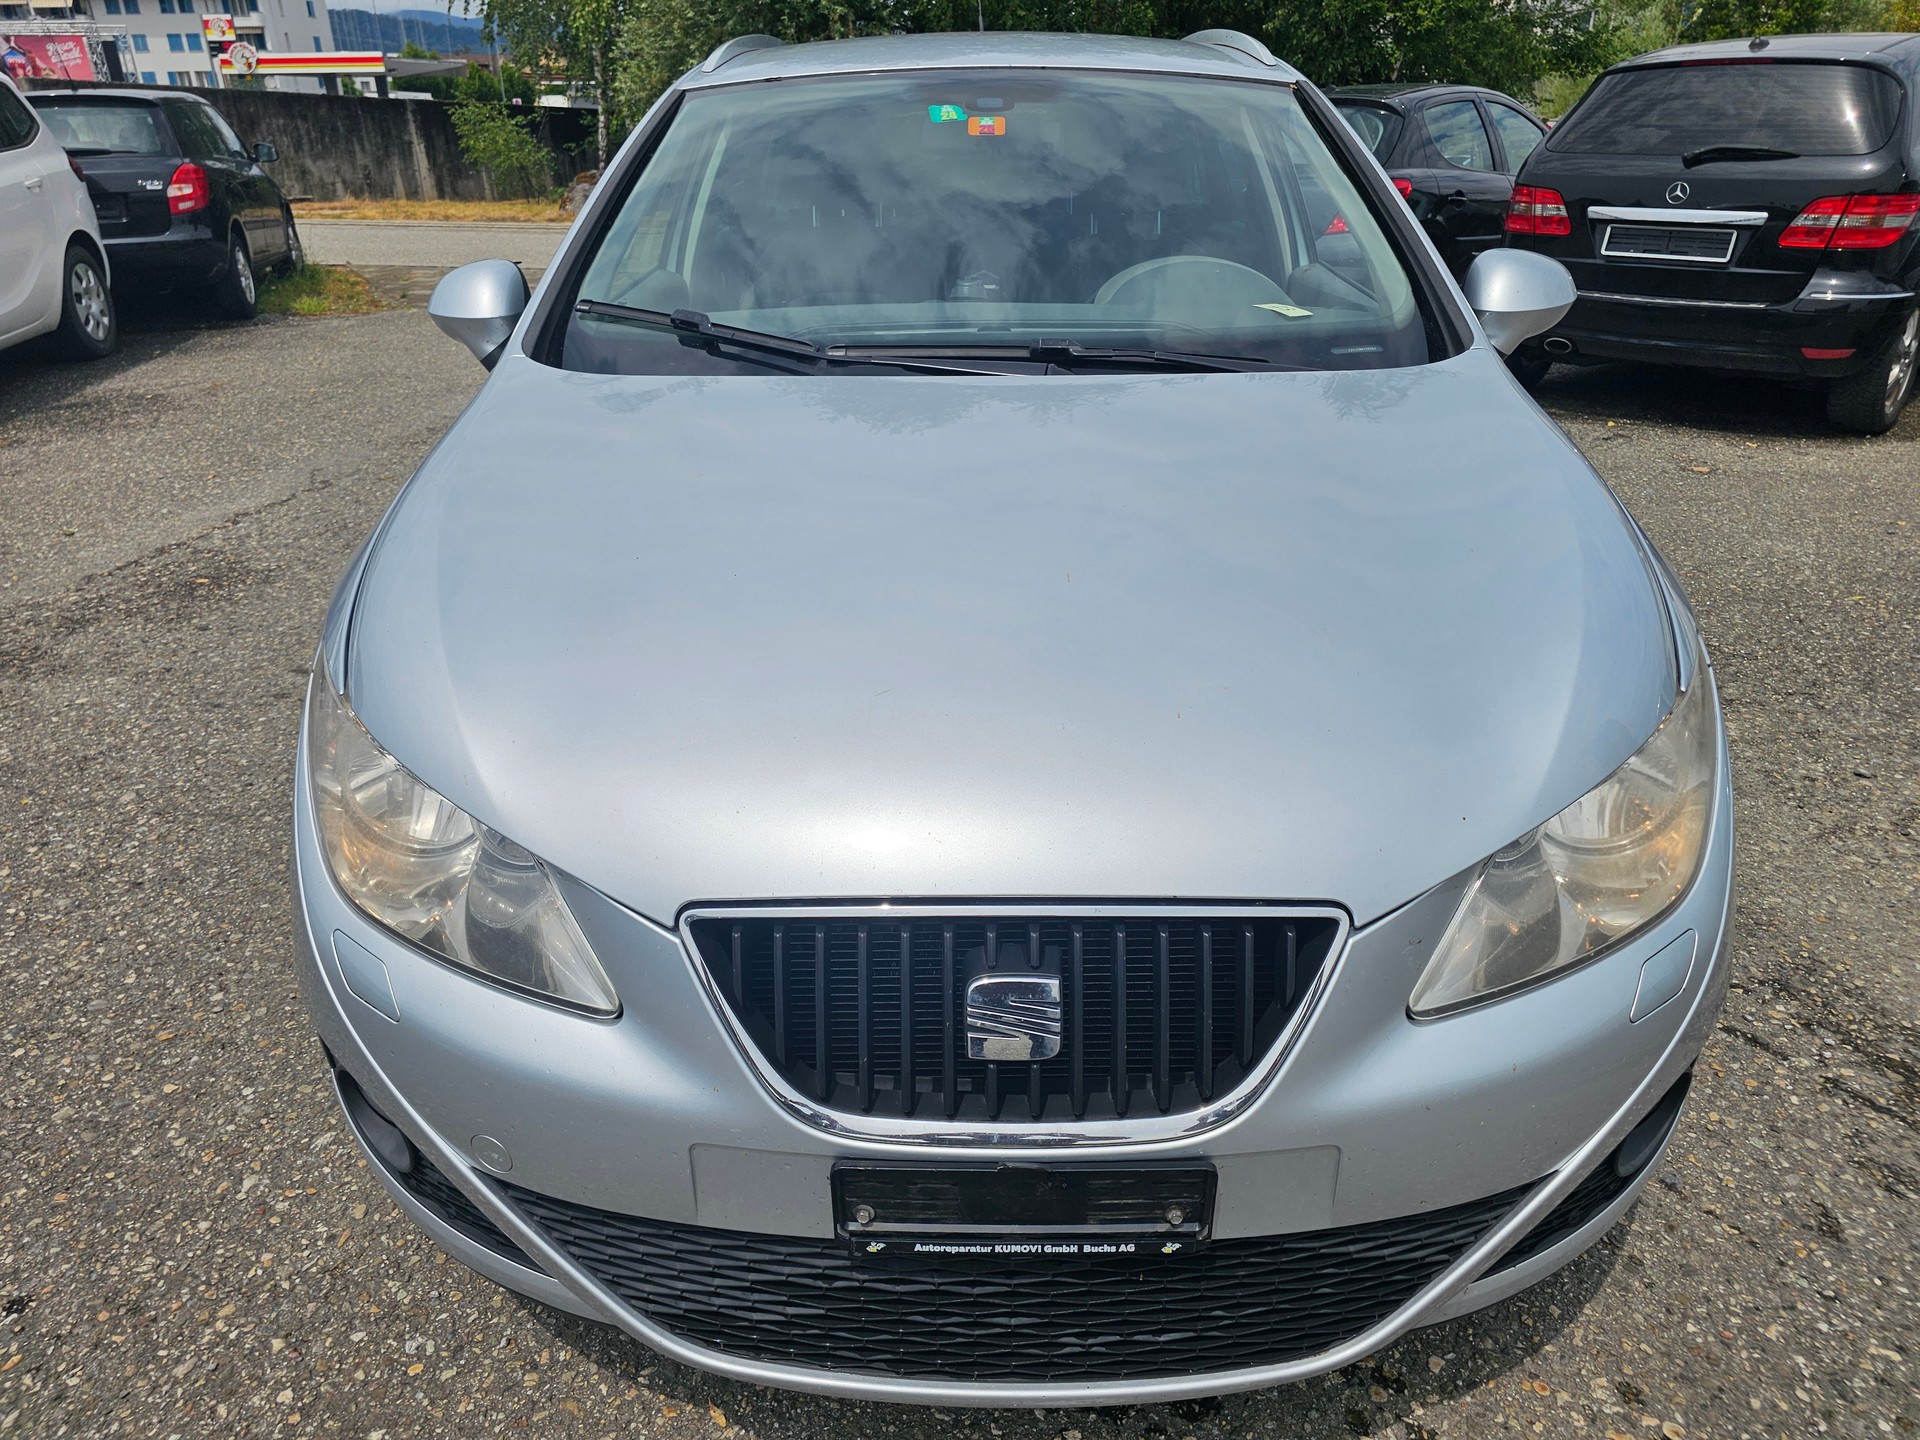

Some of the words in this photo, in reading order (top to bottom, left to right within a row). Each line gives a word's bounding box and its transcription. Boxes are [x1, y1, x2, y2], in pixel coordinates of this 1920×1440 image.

[914, 1243, 993, 1254] Autoreparatur
[994, 1244, 1042, 1253] KUMOVI
[1043, 1244, 1079, 1253] GmbH
[1083, 1244, 1117, 1253] Buchs
[1118, 1243, 1136, 1252] AG
